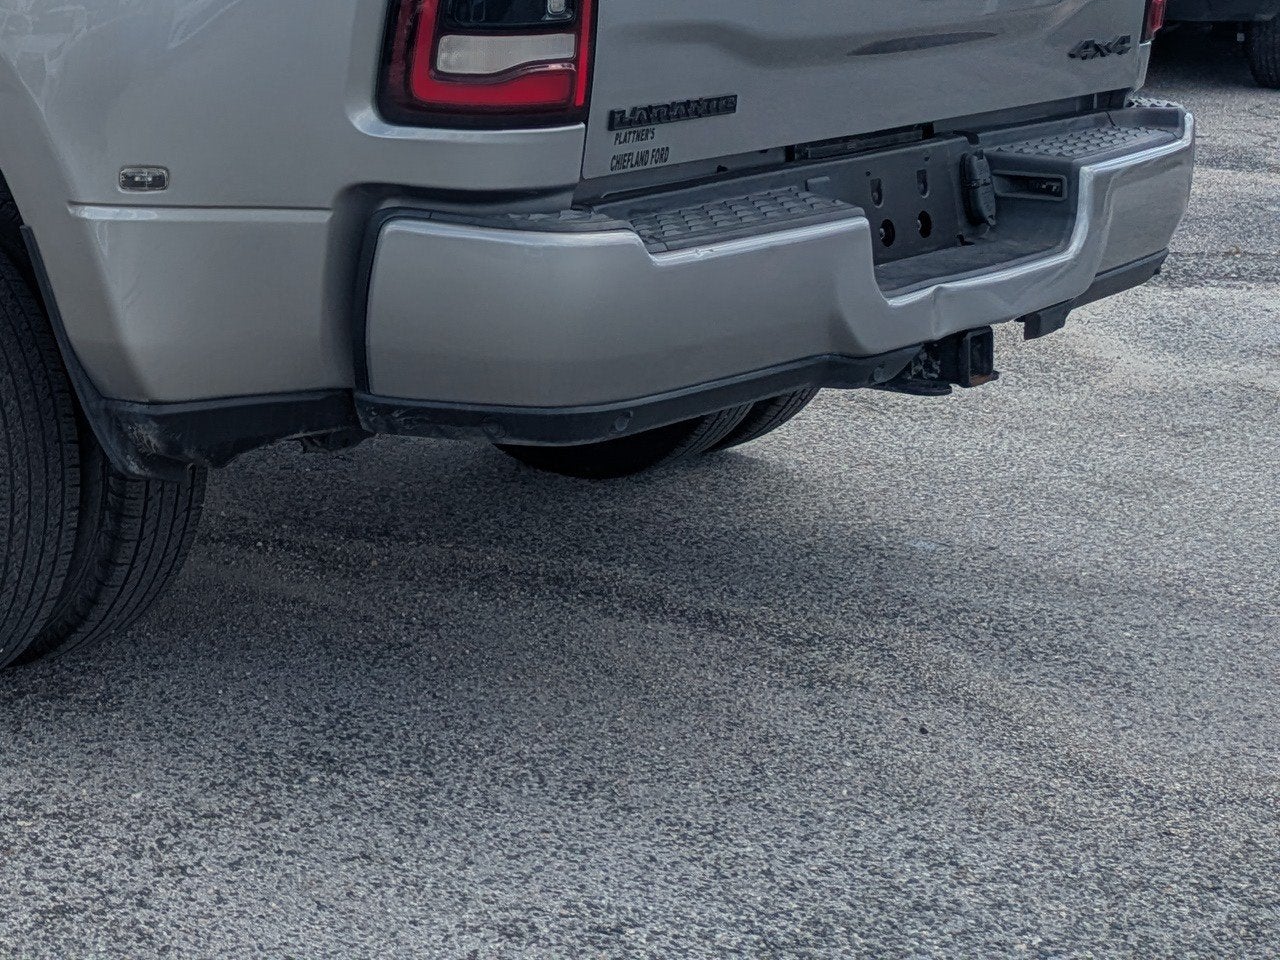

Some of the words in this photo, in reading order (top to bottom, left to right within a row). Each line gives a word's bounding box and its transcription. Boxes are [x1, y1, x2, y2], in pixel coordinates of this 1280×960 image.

[608, 94, 738, 131] LARAMIE
[613, 127, 656, 145] PLATTNER'S
[610, 150, 650, 171] CHIEFLAND
[649, 146, 670, 165] FORD
